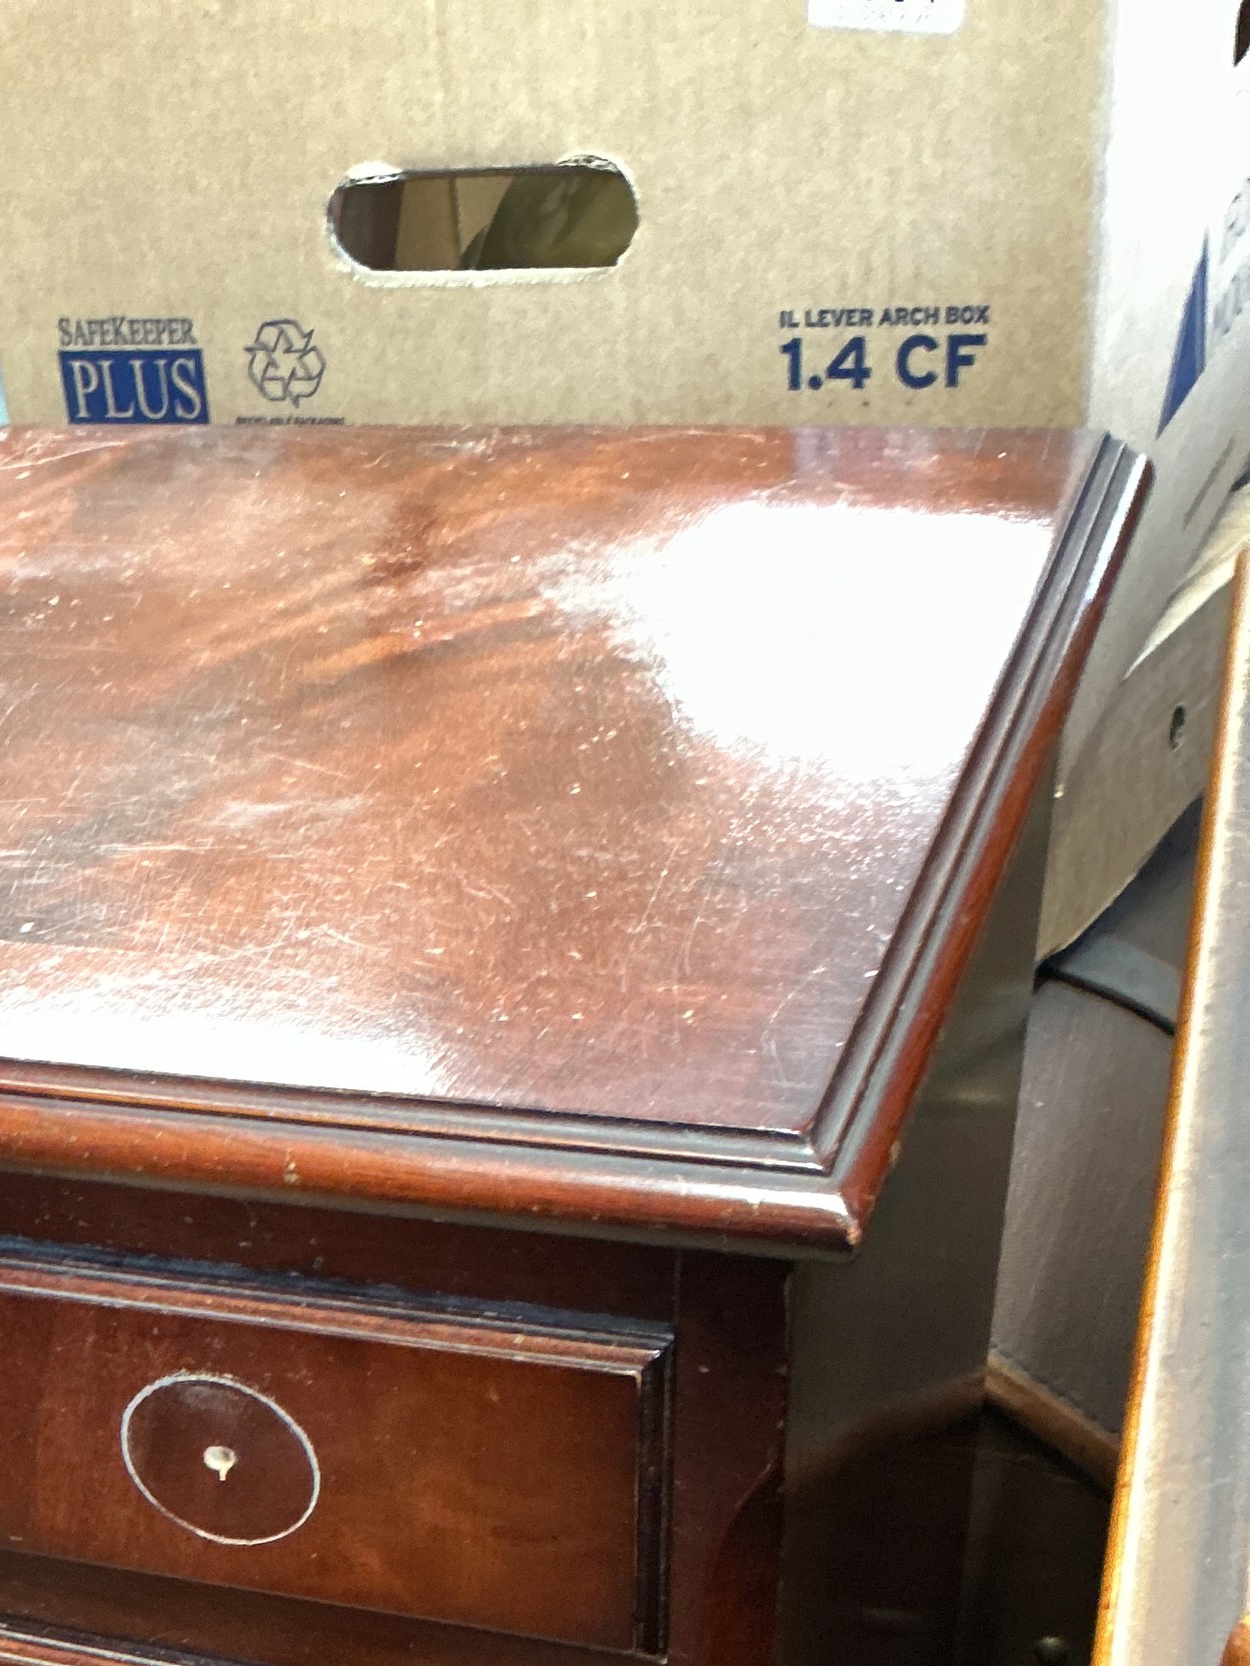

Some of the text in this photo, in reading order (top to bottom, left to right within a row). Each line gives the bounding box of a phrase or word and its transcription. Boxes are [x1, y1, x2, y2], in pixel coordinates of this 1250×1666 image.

[57, 315, 198, 347] SAFEKEEPER
[805, 308, 874, 328] LEVER
[879, 305, 940, 326] ARCH
[944, 304, 991, 325] BOX
[779, 333, 988, 391] 1.4 CF
[67, 357, 202, 420] PLUS
